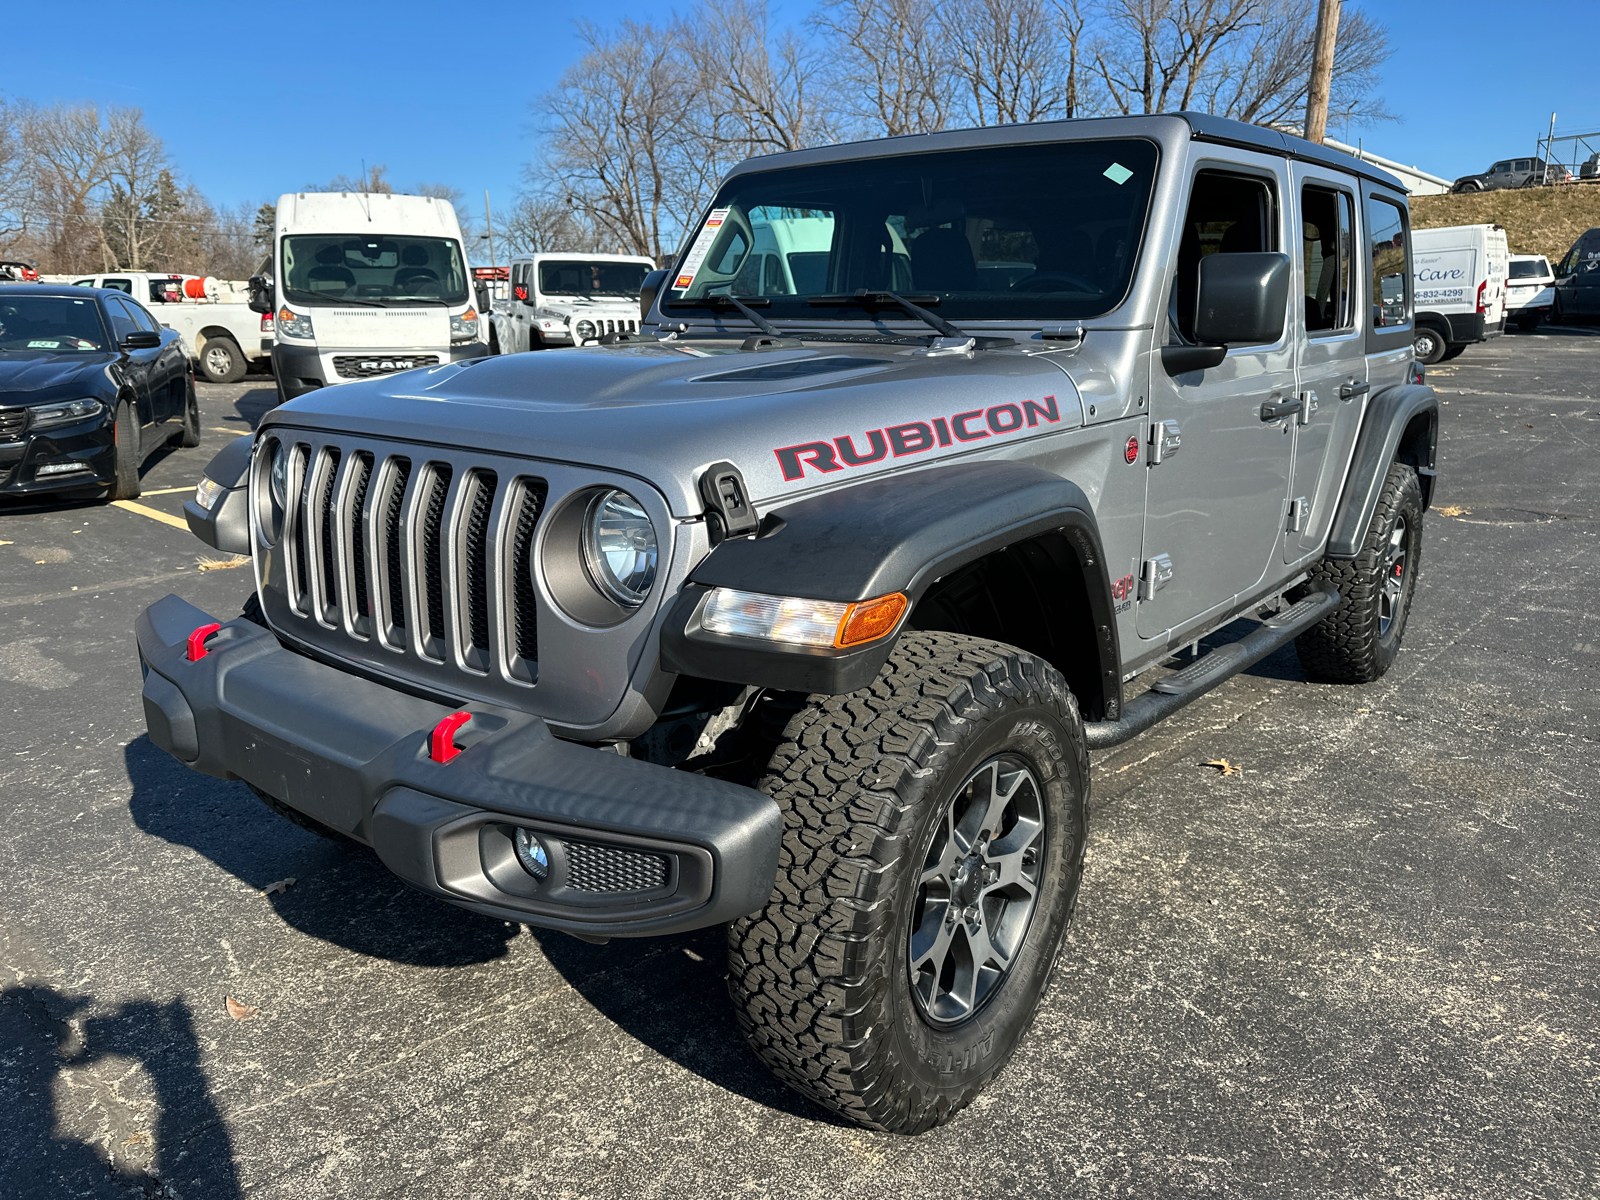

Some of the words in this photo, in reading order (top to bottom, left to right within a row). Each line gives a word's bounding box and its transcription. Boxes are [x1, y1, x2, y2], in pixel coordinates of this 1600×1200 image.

[360, 361, 413, 369] RAM
[774, 395, 1061, 482] RUBICON
[1114, 600, 1132, 613] GLER
[1008, 721, 1074, 890] BFGoodrich
